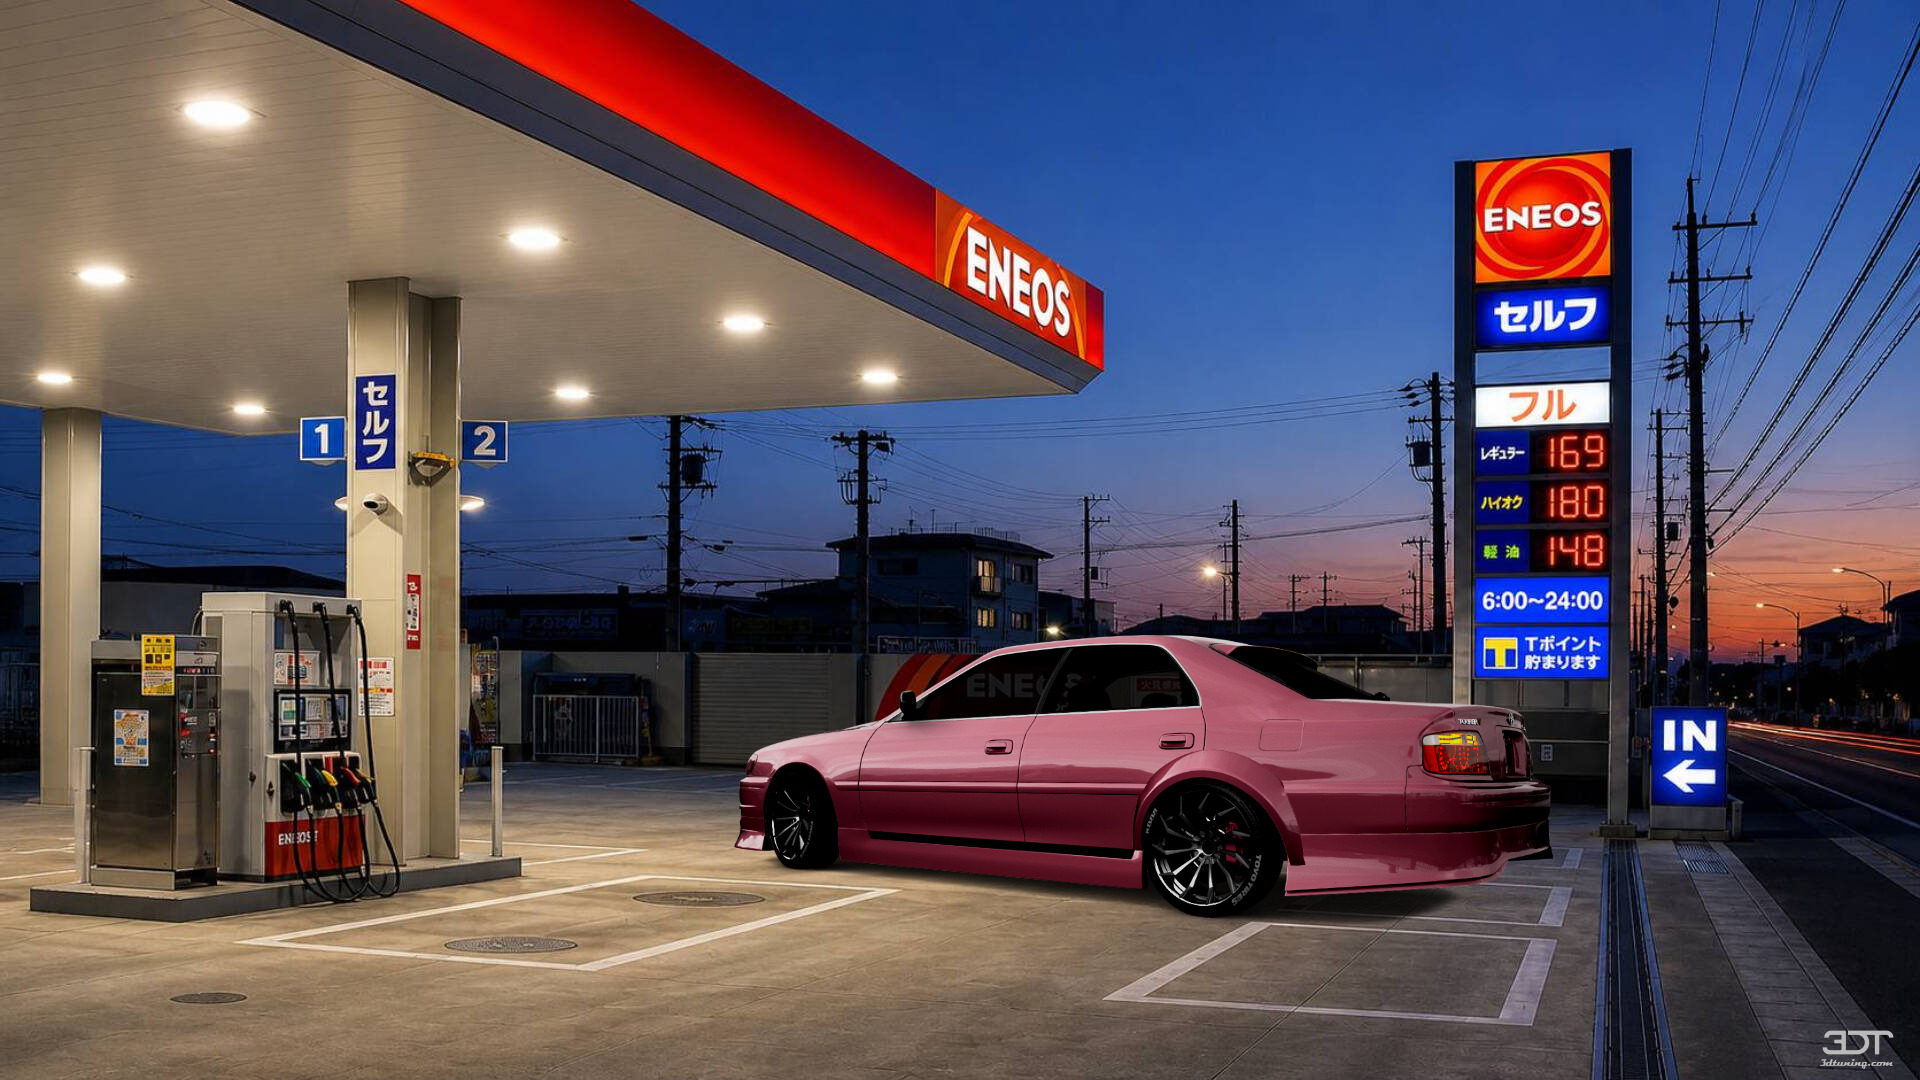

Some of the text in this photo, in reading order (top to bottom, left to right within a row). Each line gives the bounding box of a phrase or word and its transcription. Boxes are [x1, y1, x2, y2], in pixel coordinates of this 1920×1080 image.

[1484, 201, 1602, 233] ENEOS
[967, 226, 1071, 337] ENEOS
[1494, 298, 1597, 333] セルフ
[1509, 389, 1577, 422] フル
[362, 381, 389, 464] セルフ
[314, 423, 328, 454] 1
[474, 425, 496, 456] 2
[1481, 445, 1525, 461] レギュラー
[1550, 435, 1604, 468] 169
[1481, 494, 1523, 510] ハイオク
[1550, 485, 1604, 518] 180
[1550, 535, 1604, 566] 148
[1482, 591, 1604, 610] 6:00~24:00
[1524, 635, 1602, 652] Tポイント
[1524, 654, 1601, 670] 貯まります
[1663, 720, 1717, 751] IN
[1231, 854, 1262, 906] TOYO TIRES
